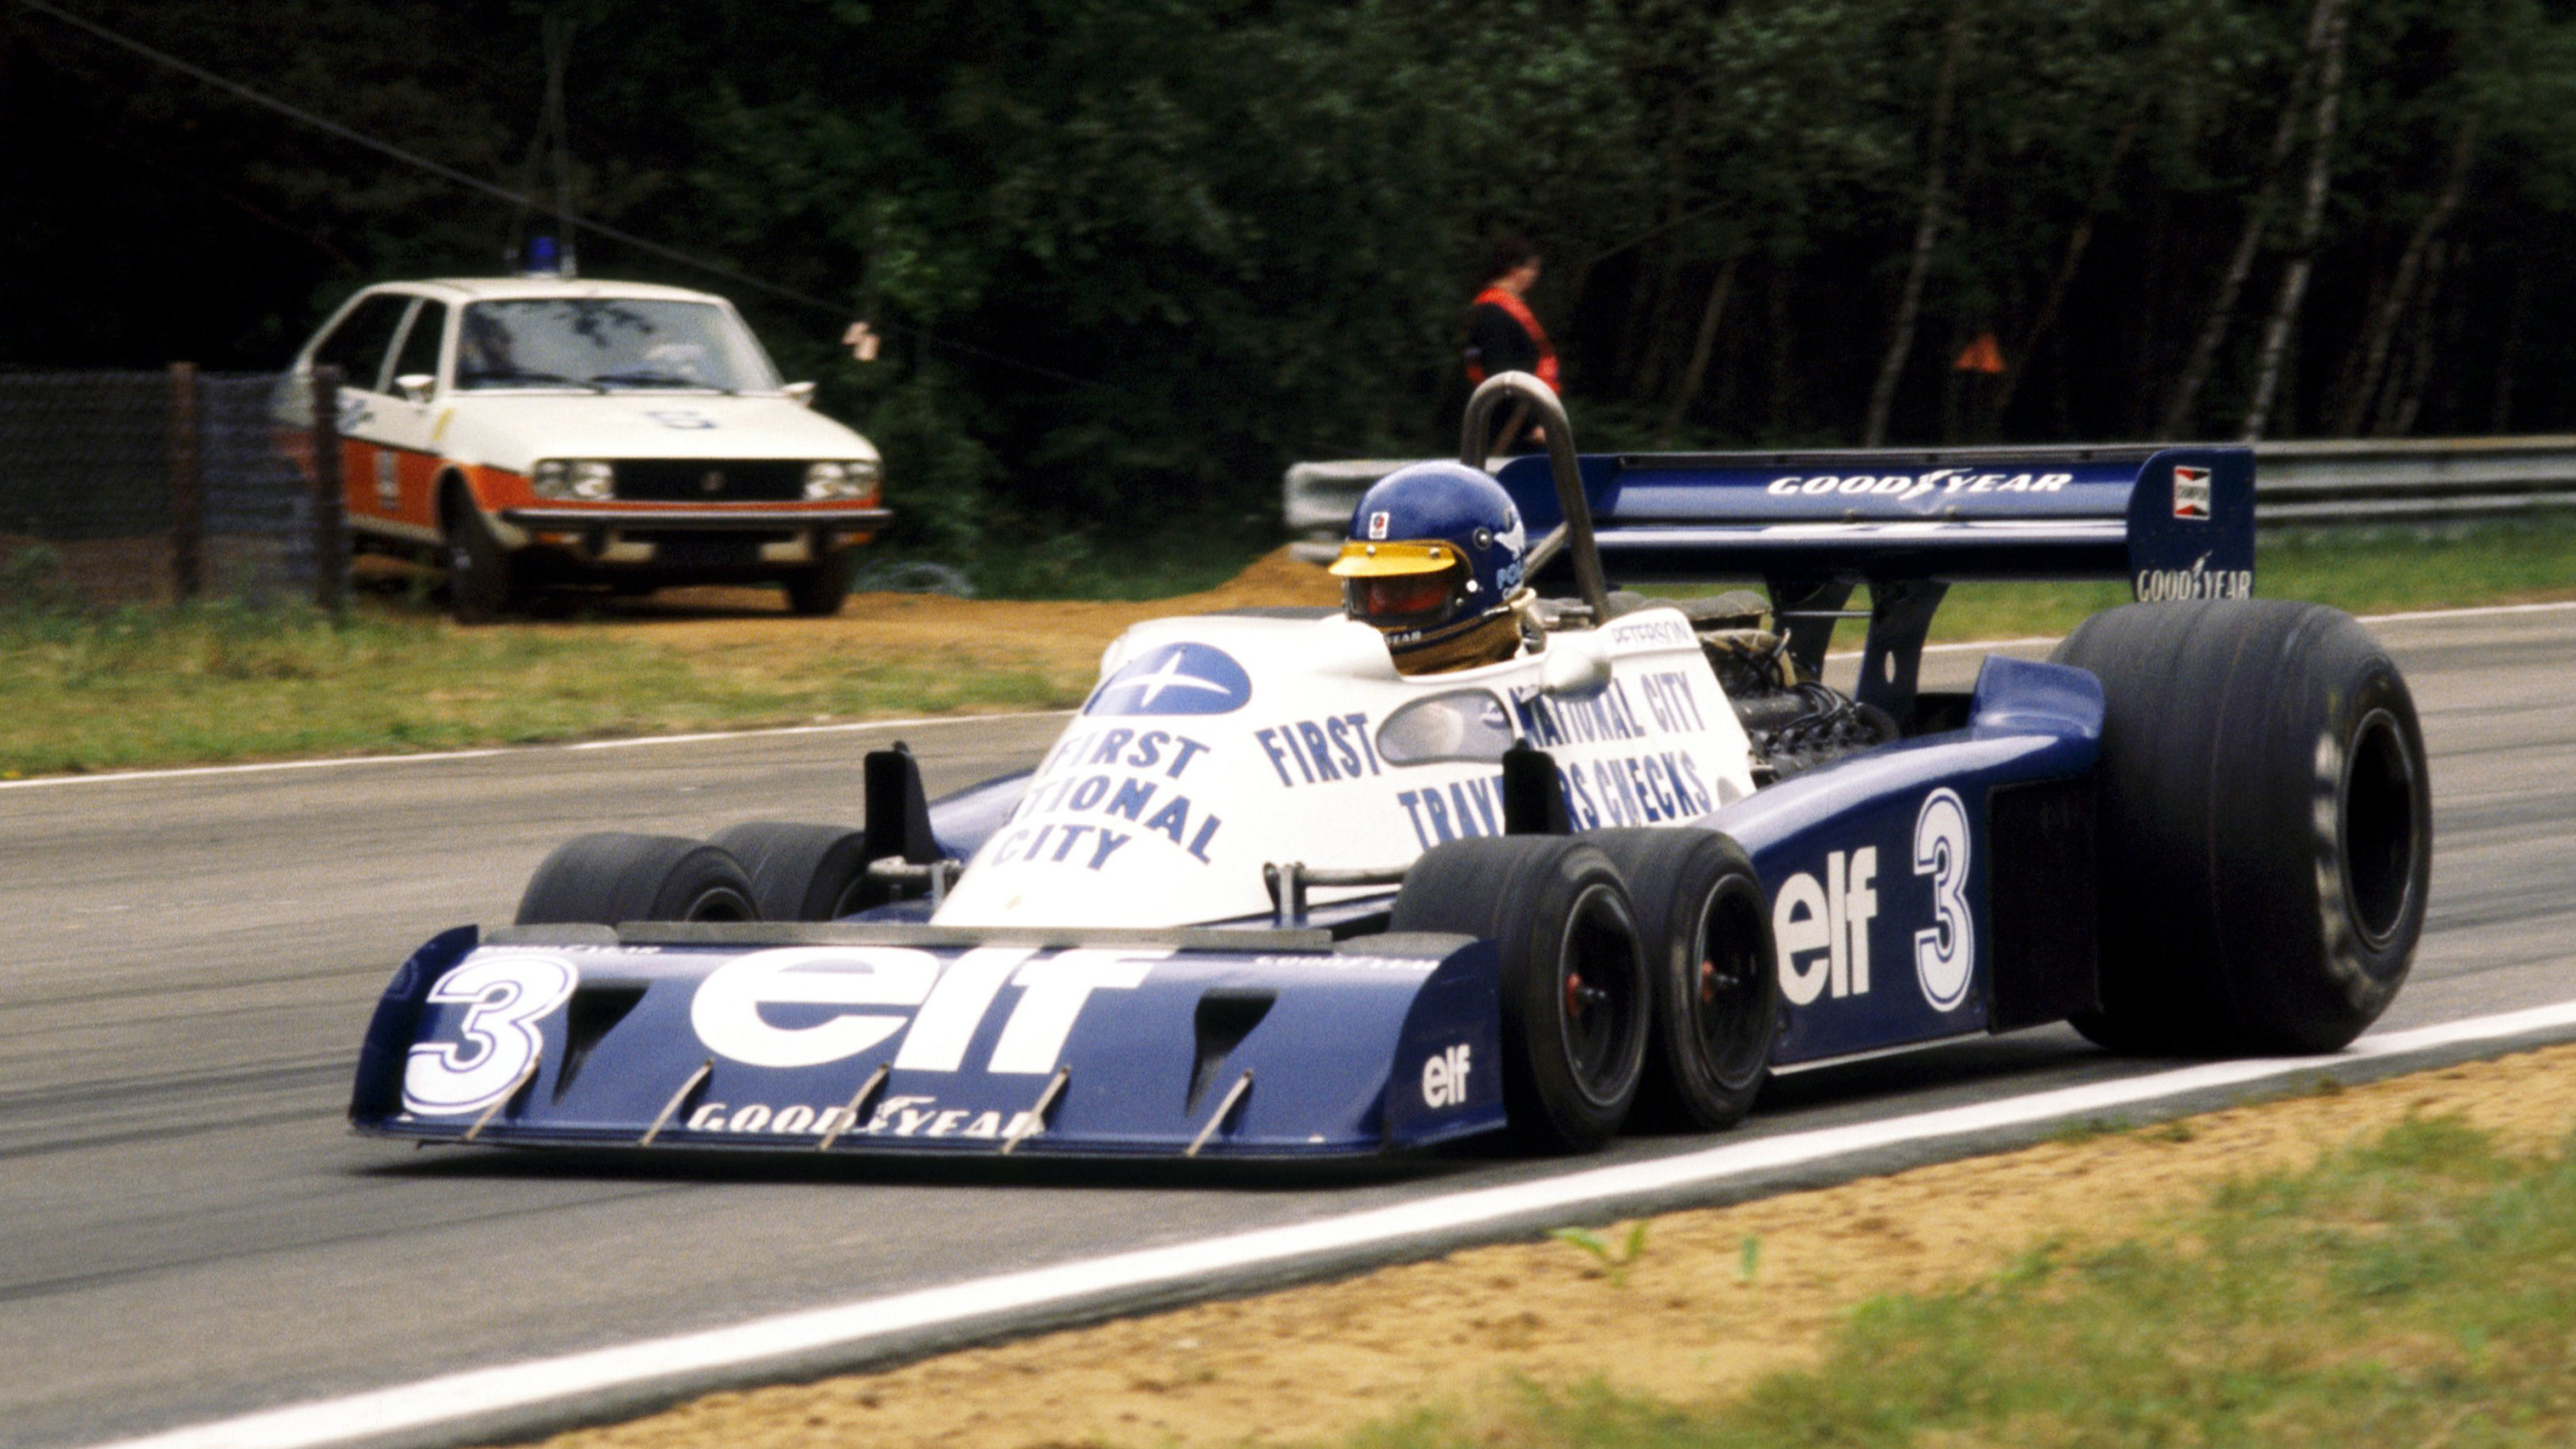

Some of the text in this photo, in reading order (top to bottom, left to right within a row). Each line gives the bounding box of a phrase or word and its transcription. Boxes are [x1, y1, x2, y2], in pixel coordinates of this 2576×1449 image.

[1767, 468, 2073, 501] GOODYEAR
[2137, 557, 2252, 601] GOODYEAR
[1611, 620, 1690, 646] PETERSON
[1042, 727, 1211, 780] FIRST
[1254, 713, 1381, 787] FIRST
[1641, 671, 1706, 733] CITY
[1021, 774, 1222, 867] TIONAL
[1593, 749, 1714, 827] CHECKS
[991, 824, 1132, 871] CITY
[1772, 787, 1975, 1012] elf 3
[401, 951, 579, 1116] 3
[691, 946, 1180, 1074] elf
[1422, 1043, 1471, 1109] elf
[688, 1095, 1046, 1139] GOODYEAR
